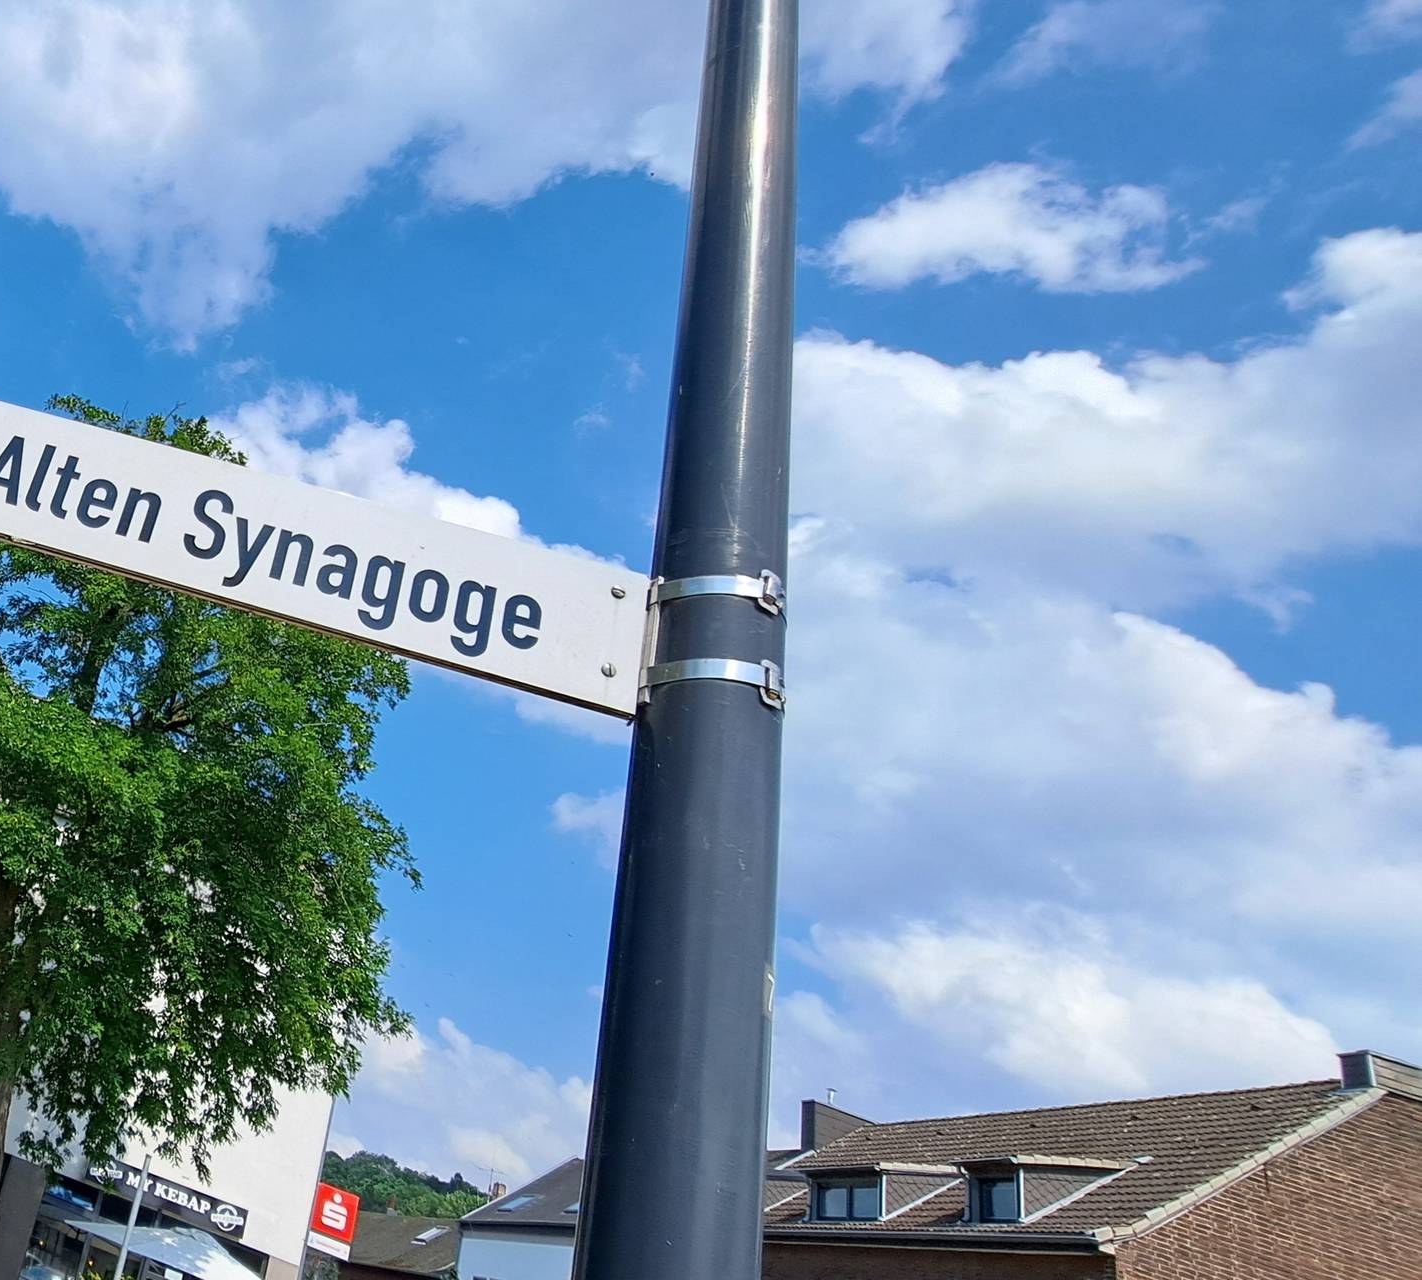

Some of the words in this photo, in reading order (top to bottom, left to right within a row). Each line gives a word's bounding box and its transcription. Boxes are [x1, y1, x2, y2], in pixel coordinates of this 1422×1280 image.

[183, 489, 542, 657] Synagoge
[126, 1171, 155, 1193] MY
[154, 1182, 211, 1214] KEBAP
